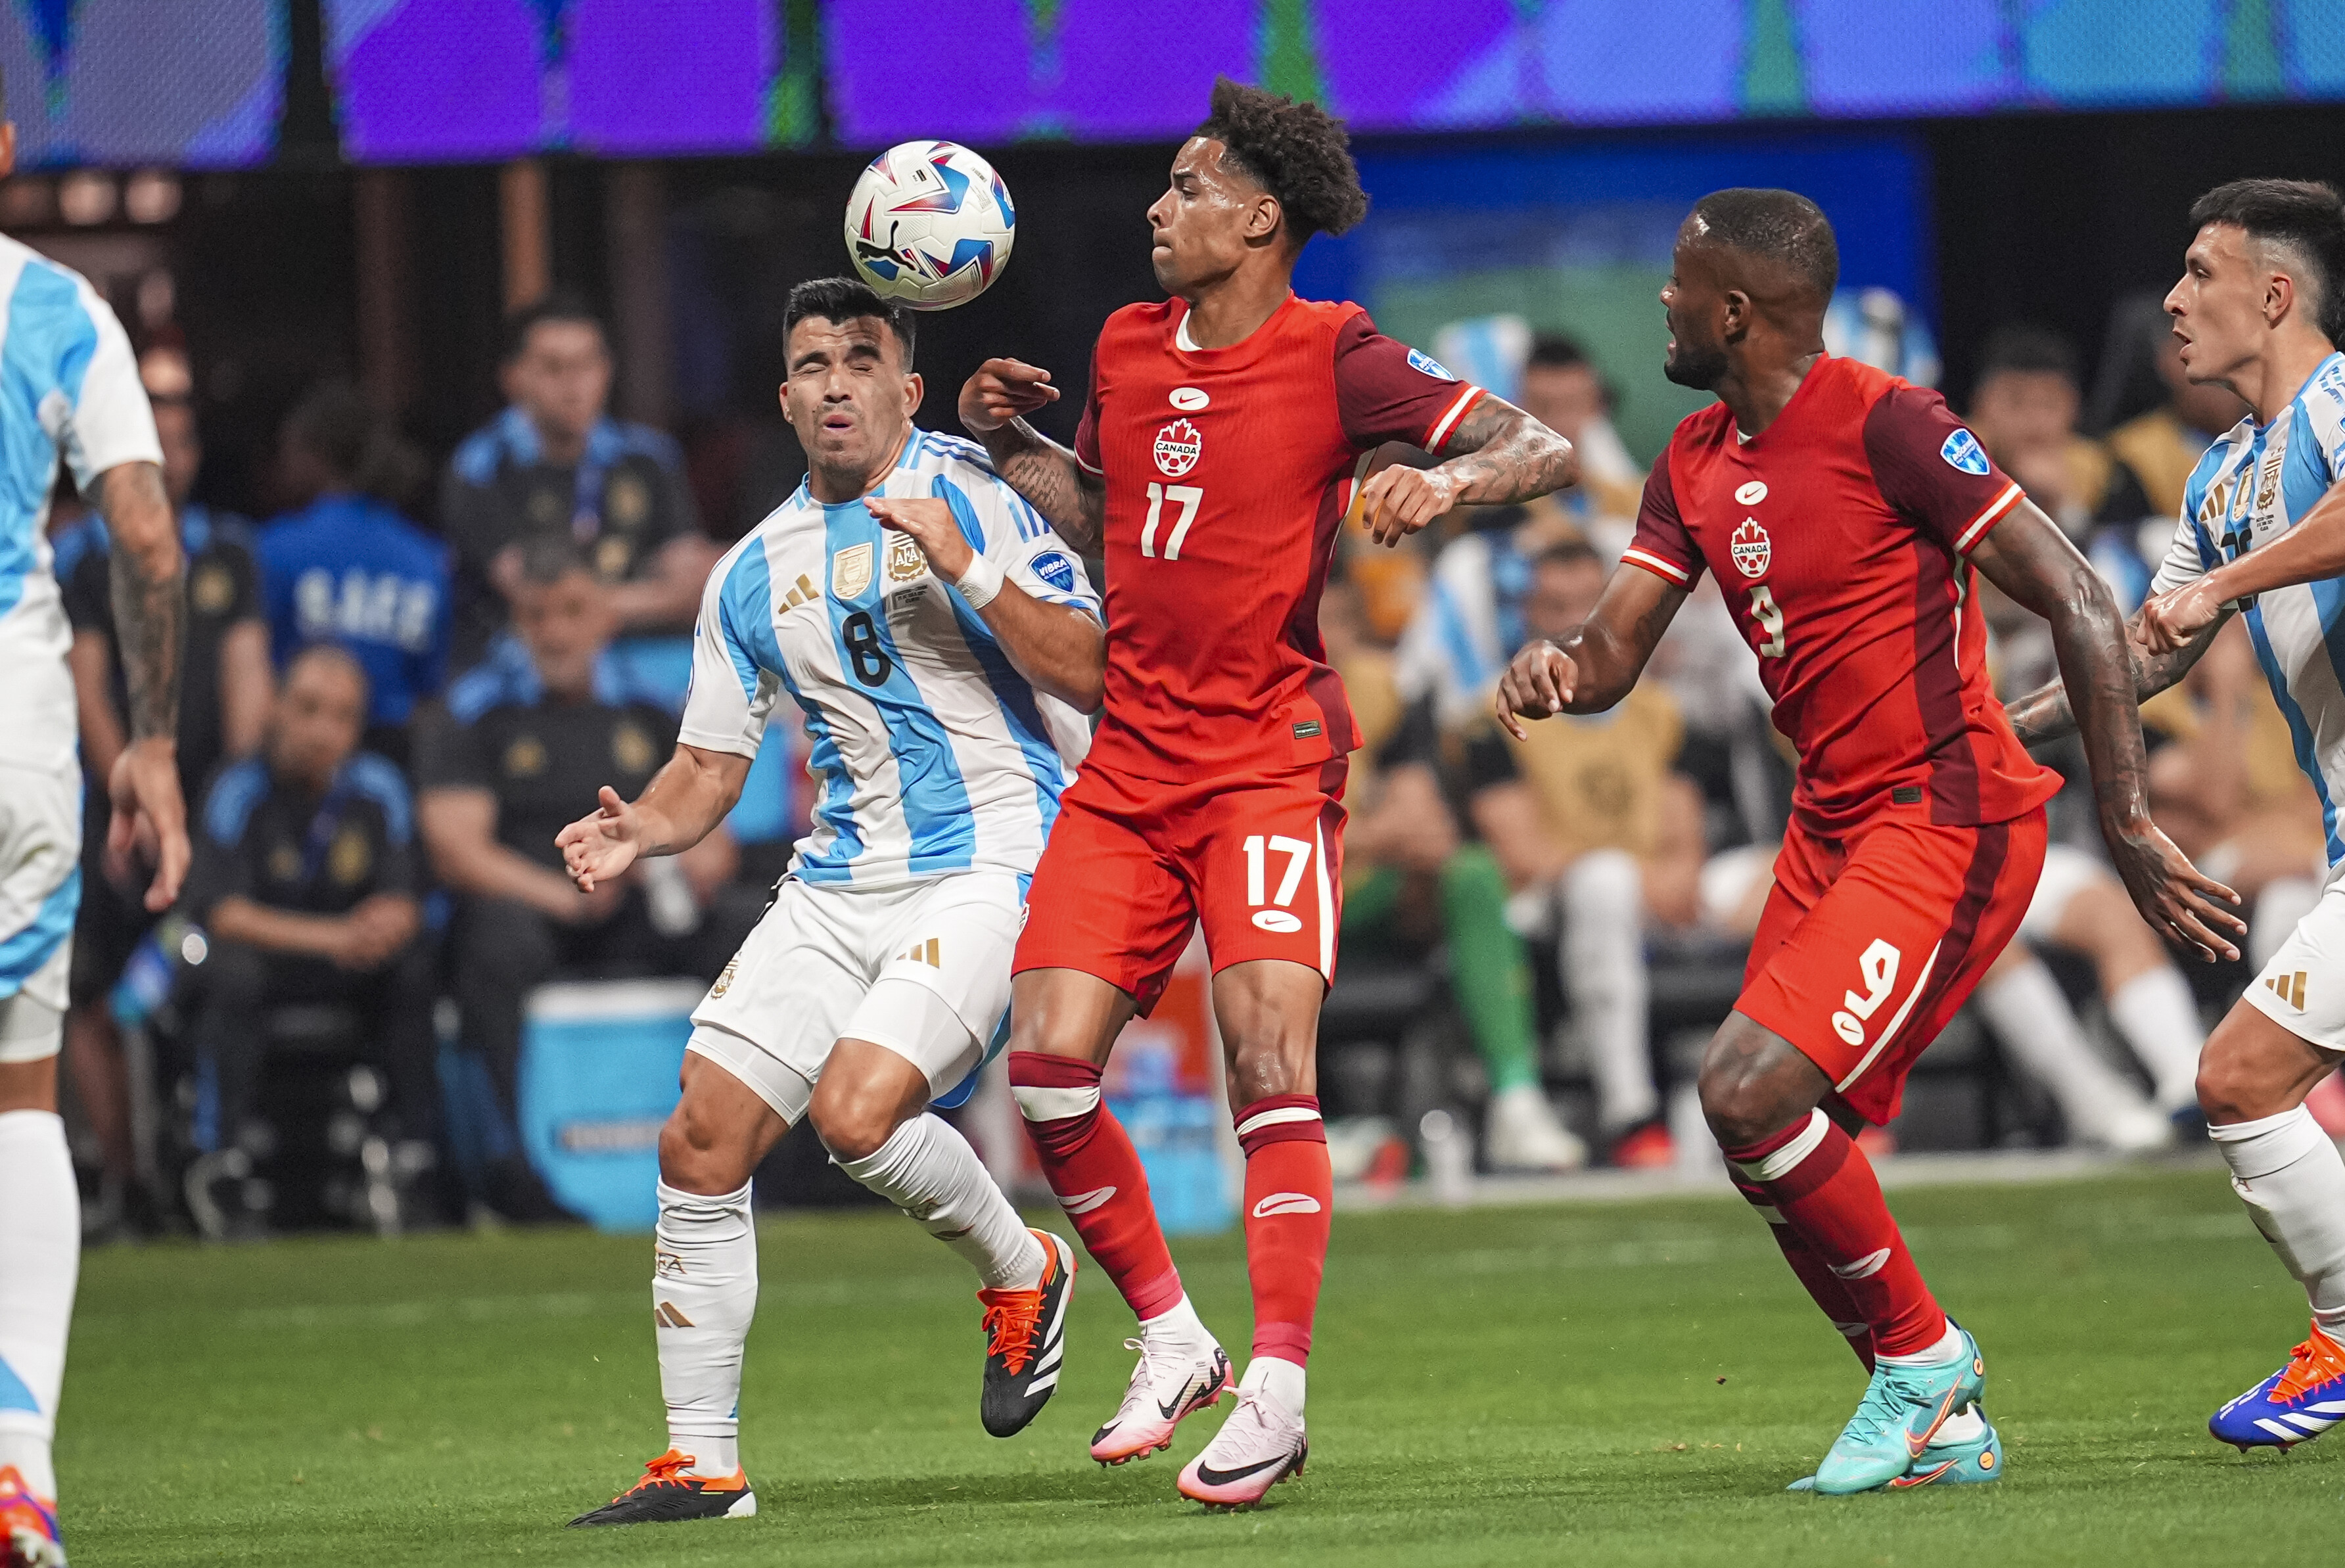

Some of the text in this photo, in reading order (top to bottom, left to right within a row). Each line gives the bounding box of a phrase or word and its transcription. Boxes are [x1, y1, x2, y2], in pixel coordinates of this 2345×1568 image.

[1155, 442, 1197, 455] CANADA
[894, 543, 919, 567] AFA
[1140, 482, 1203, 560] 17
[1733, 545, 1768, 555] CANADA
[1039, 559, 1068, 576] VIBRA
[843, 611, 891, 687] 8
[1749, 586, 1786, 658] 9
[1243, 835, 1312, 907] 17
[1844, 938, 1901, 1021] 9
